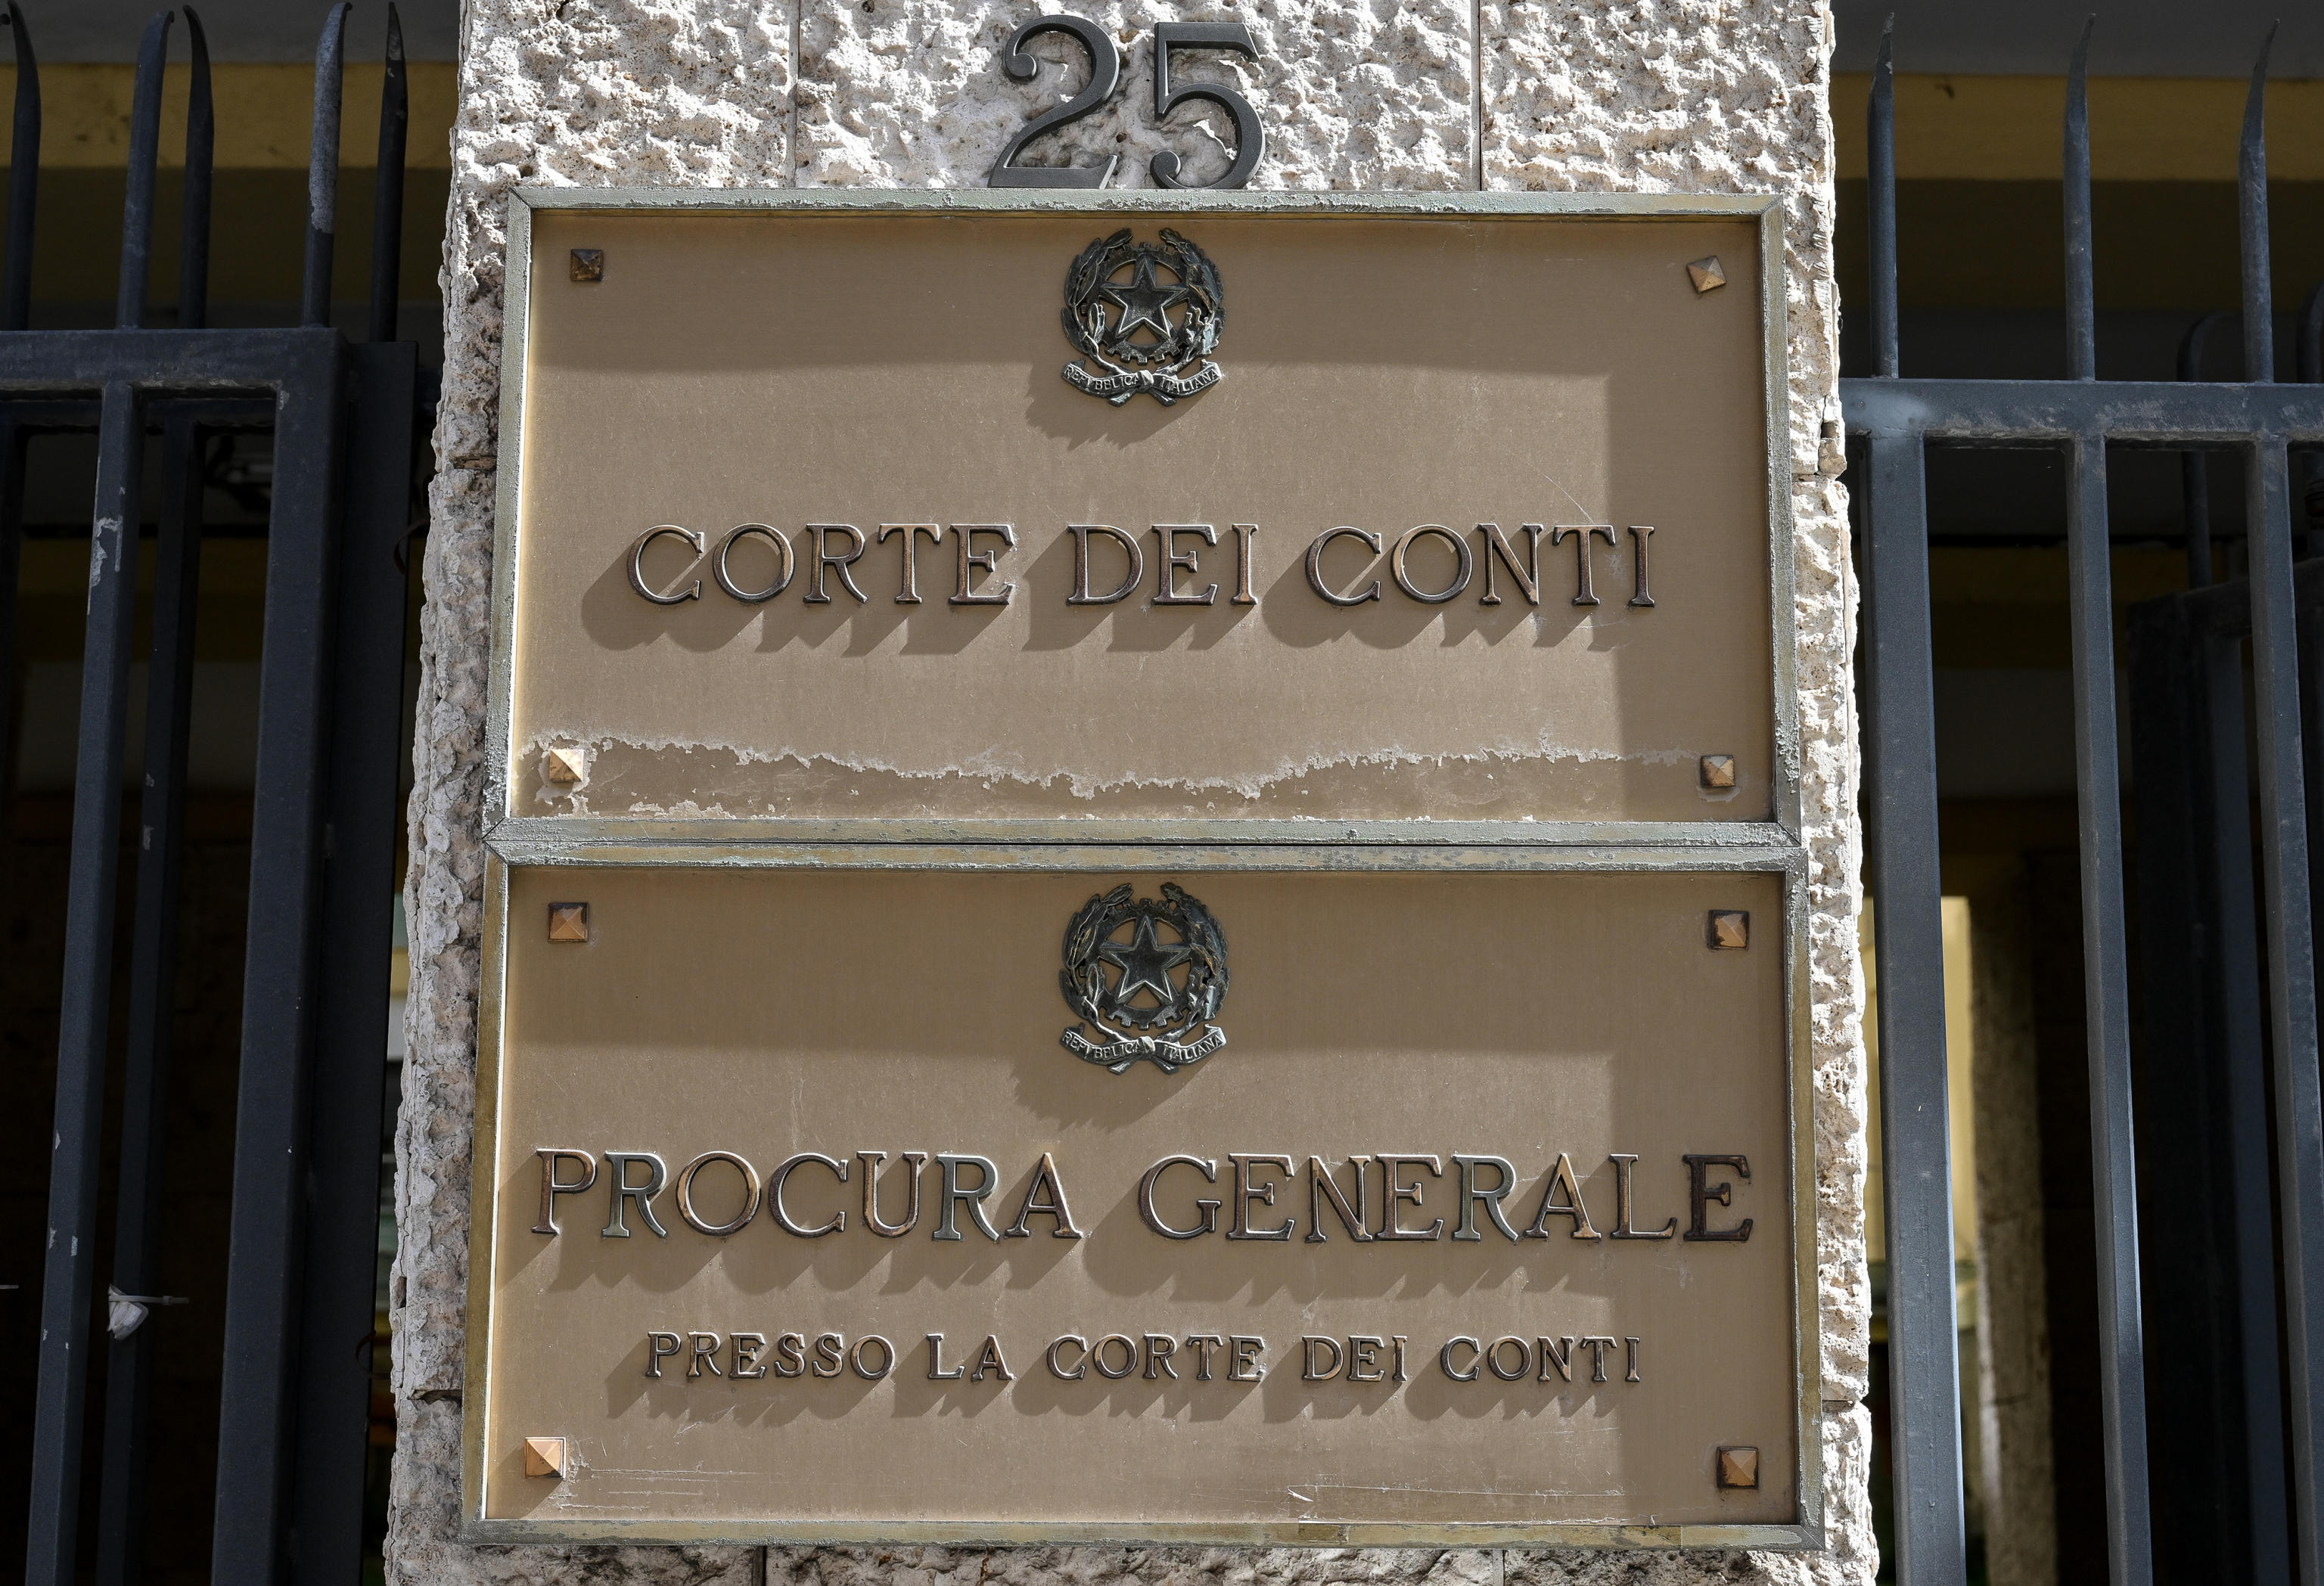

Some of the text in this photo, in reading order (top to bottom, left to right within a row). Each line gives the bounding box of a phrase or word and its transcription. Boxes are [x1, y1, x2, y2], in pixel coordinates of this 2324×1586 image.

[986, 14, 1266, 189] 25
[1160, 368, 1219, 393] ITALIANA
[626, 523, 1656, 607] CORTE DEI CONTI
[1163, 1035, 1224, 1060] ITALIANA
[531, 1148, 1754, 1243] PROCURA GENERALE
[645, 1331, 1640, 1383] PRESSO LA CORTE DEI CONTI
